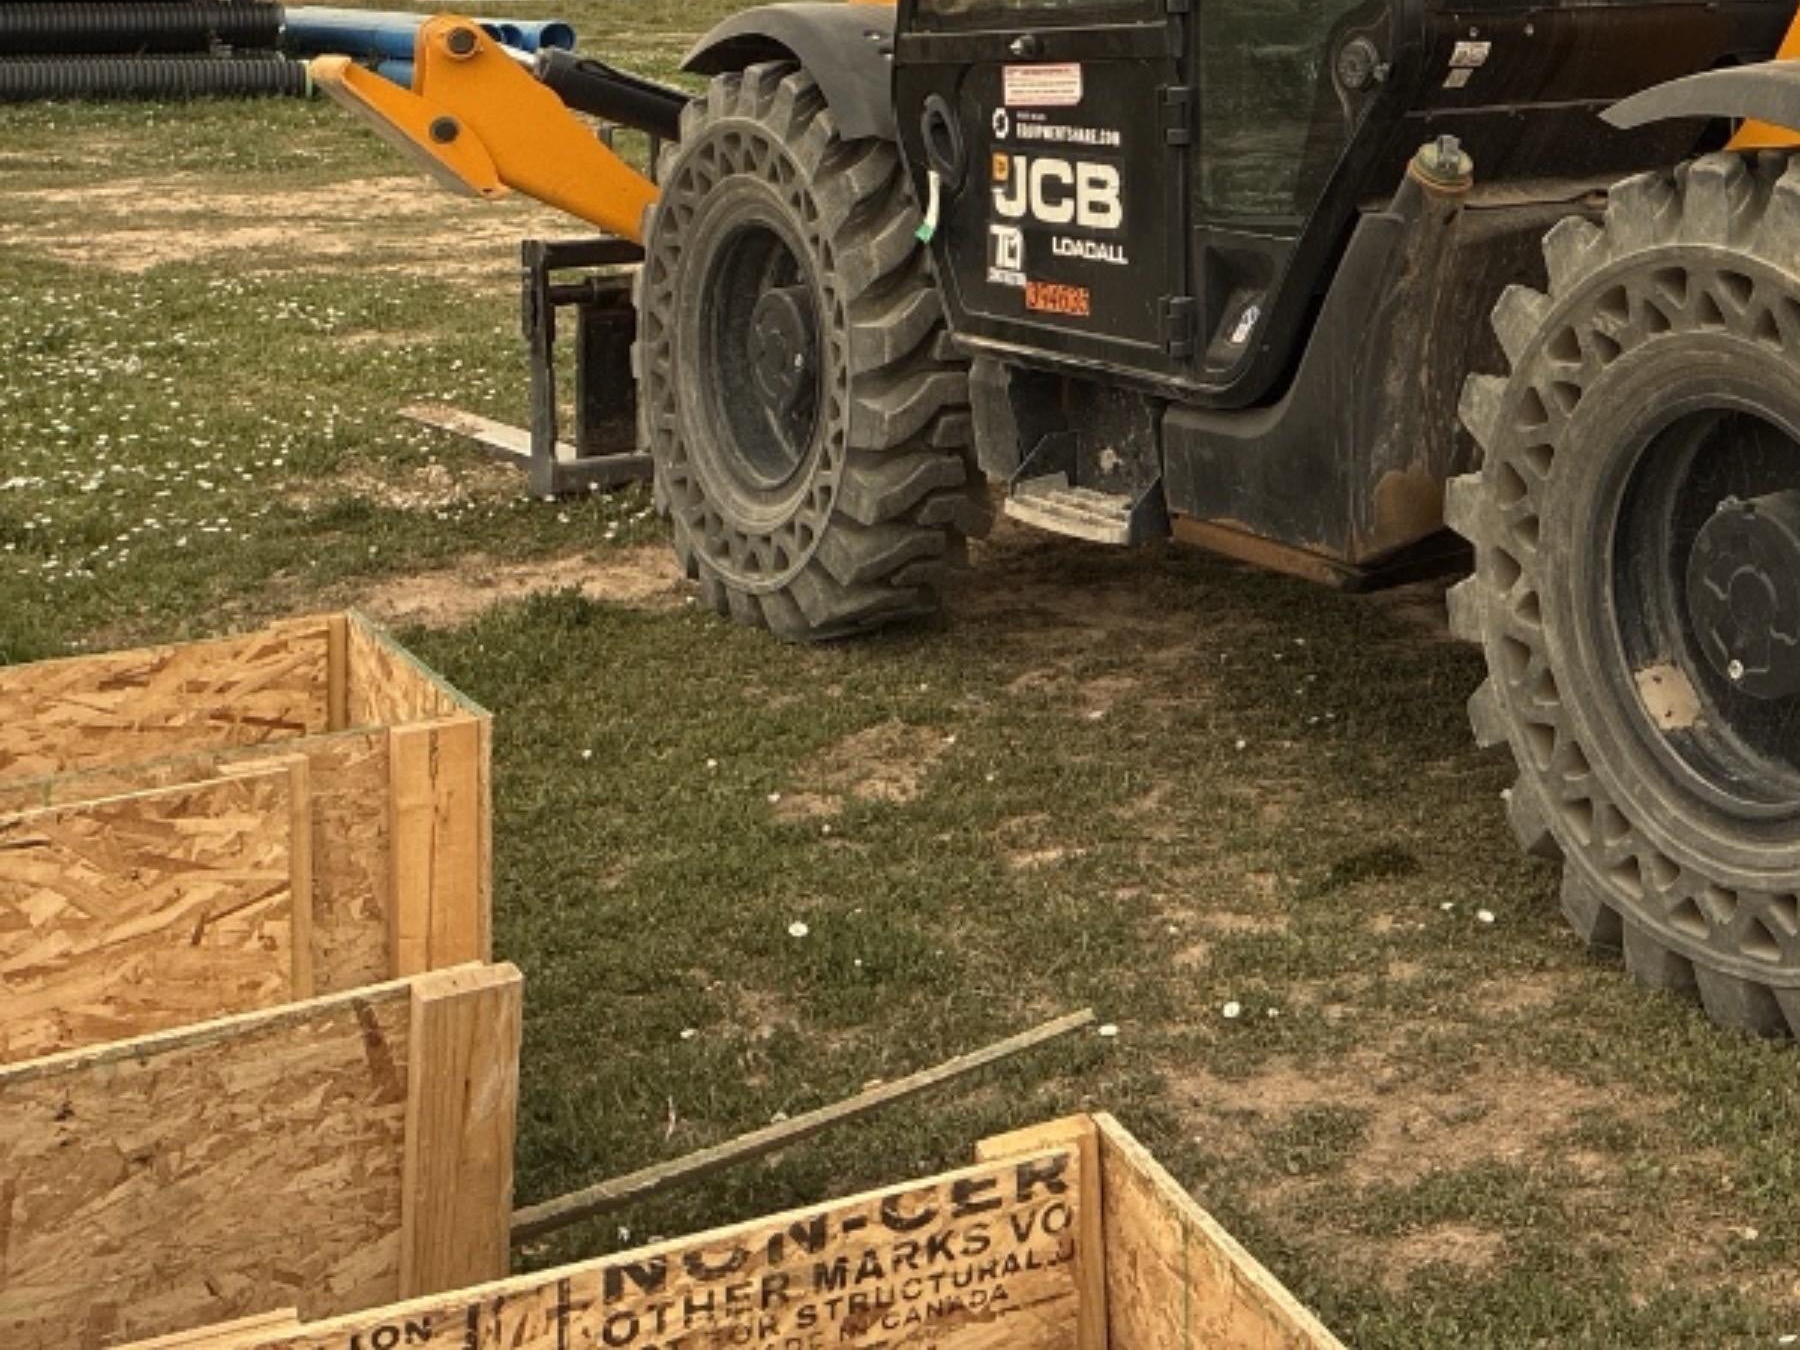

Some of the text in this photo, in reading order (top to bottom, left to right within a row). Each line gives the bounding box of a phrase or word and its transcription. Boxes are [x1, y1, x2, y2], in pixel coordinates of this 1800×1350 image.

[991, 155, 1124, 230] JCB
[1052, 236, 1130, 265] LOADALL
[602, 1269, 791, 1347] OTHER
[813, 1221, 992, 1292] MARKS
[1010, 1201, 1074, 1243] VO
[797, 1246, 1043, 1329] STRUCTURAL
[881, 1283, 1010, 1331] CANADA
